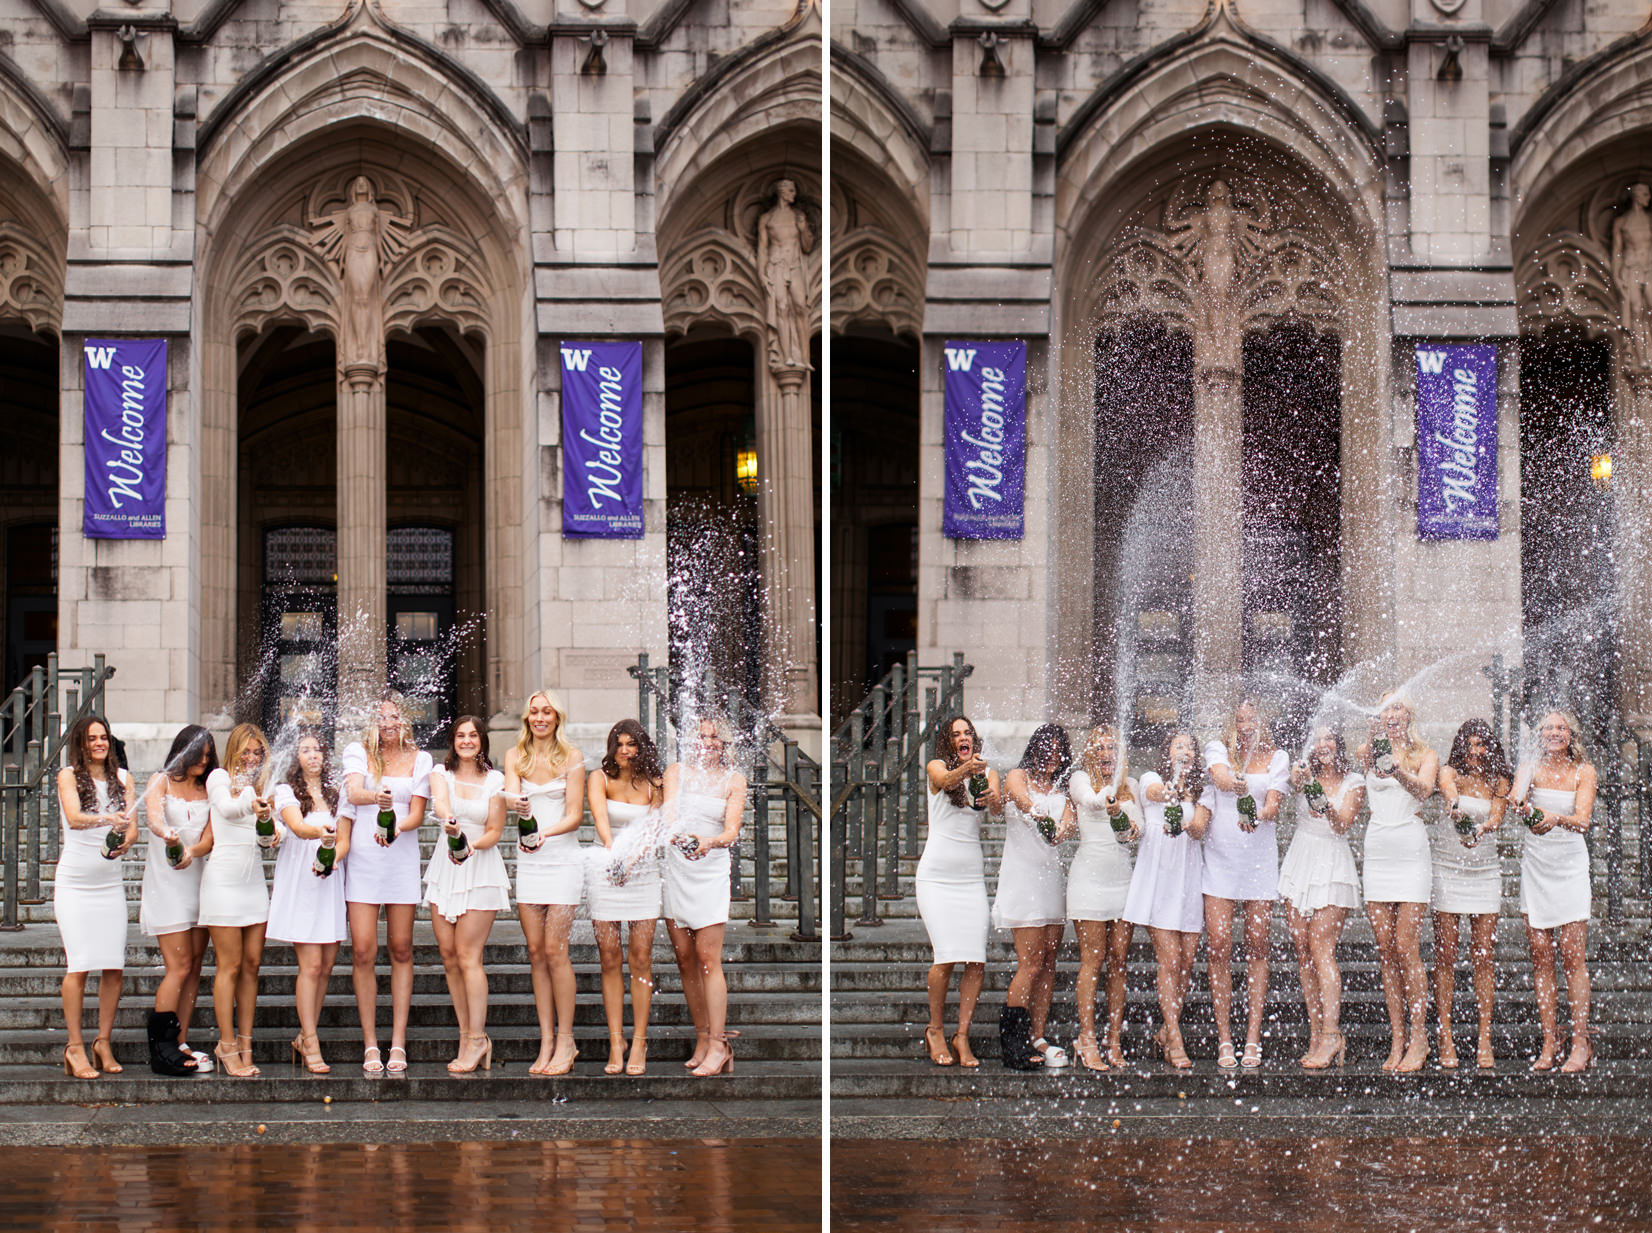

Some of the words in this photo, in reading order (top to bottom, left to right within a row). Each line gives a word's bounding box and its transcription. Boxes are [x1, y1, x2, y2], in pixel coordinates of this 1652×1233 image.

[84, 346, 116, 369] W
[560, 348, 592, 371] W
[944, 348, 977, 371] W
[1416, 350, 1447, 373] W
[101, 365, 145, 508] Welcome
[579, 366, 622, 509] Welcome
[961, 366, 1005, 509] Welcome
[1434, 368, 1477, 510] Welcome
